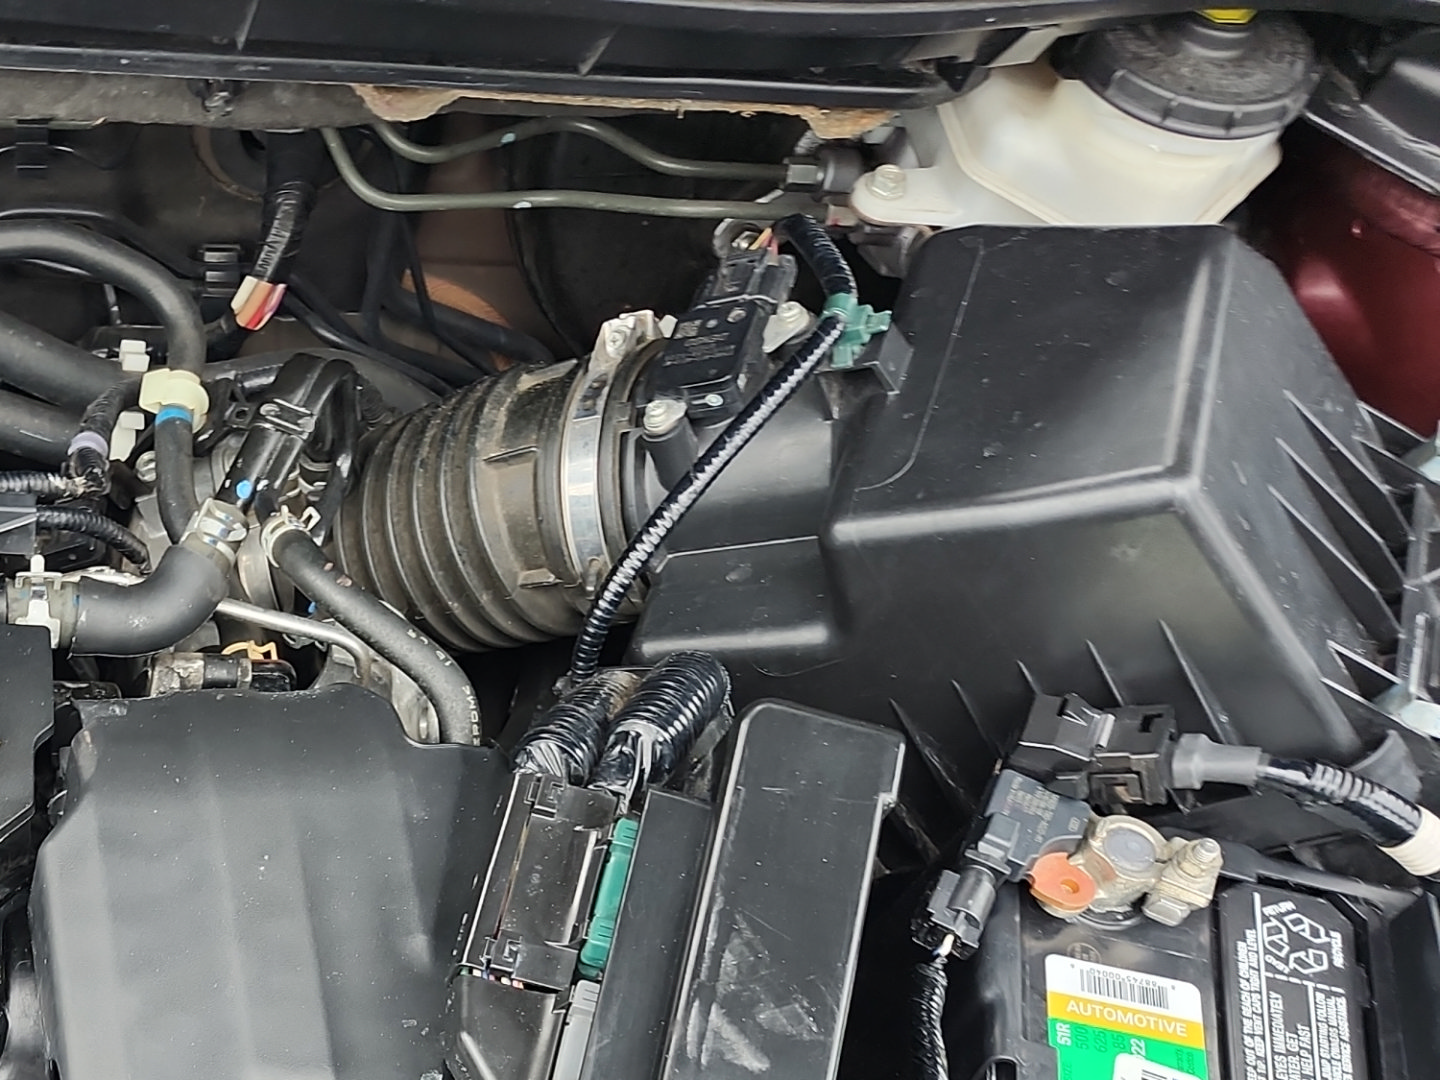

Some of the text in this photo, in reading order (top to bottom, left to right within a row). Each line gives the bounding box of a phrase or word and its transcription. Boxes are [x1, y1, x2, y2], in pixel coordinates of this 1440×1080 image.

[1245, 929, 1257, 951] LEVEL
[1329, 930, 1345, 969] RECYCLE
[1236, 941, 1249, 978] CHILDREN
[1247, 952, 1258, 969] AND
[1239, 978, 1250, 990] OF
[1249, 969, 1260, 991] TIGHT
[1240, 991, 1252, 1017] REACH
[1251, 993, 1262, 1014] CAPS
[1315, 991, 1328, 1021] FOLLOW
[1066, 1000, 1186, 1037] AUTOMOTIVE
[1242, 1017, 1253, 1034] THE
[1252, 1014, 1263, 1035] VENT
[1269, 991, 1286, 1053] IMMEDIATELY
[1056, 1022, 1071, 1046] 51R
[1075, 1027, 1089, 1049] 500
[1094, 1030, 1107, 1052] 625
[1112, 1034, 1125, 1049] 85
[1243, 1035, 1254, 1047] OF
[1285, 1031, 1299, 1052] GET
[1297, 1024, 1312, 1050] FAST
[1317, 1021, 1330, 1059] STARTING
[1245, 1048, 1256, 1066] OUT
[1254, 1036, 1265, 1057] KEEP
[1273, 1054, 1288, 1080] EYES
[1299, 1050, 1314, 1076] HELP
[1321, 1059, 1332, 1080] JUMP
